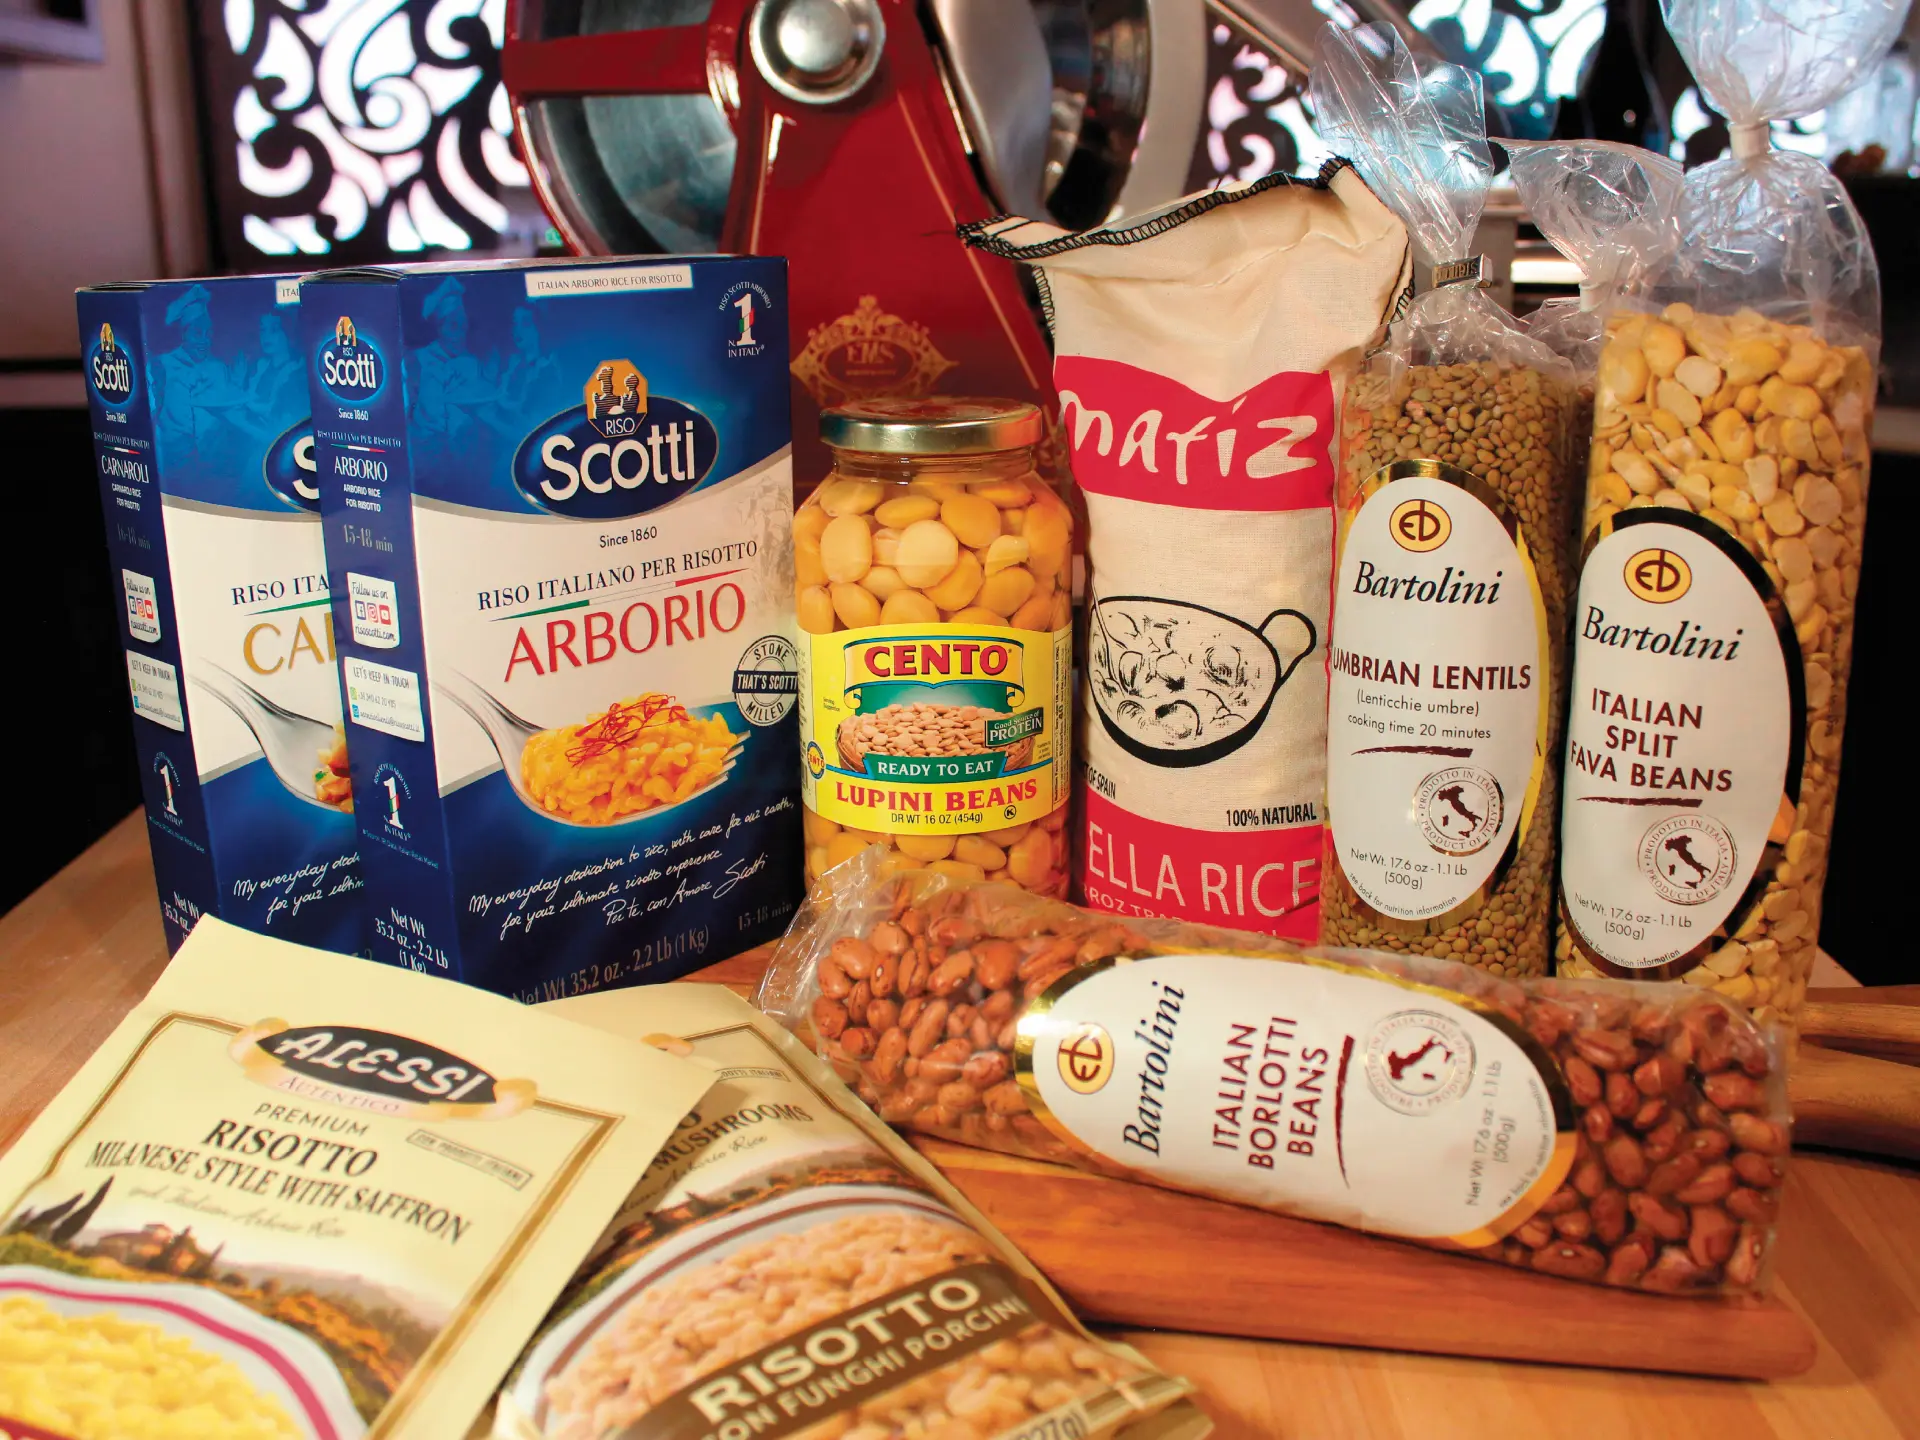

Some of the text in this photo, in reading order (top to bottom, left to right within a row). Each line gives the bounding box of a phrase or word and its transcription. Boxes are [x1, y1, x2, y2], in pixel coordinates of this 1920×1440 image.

[537, 273, 683, 290] ITALIAN ARBORIO RICE FOR RISOTTO
[719, 282, 772, 311] RISO SCOTTI ARBORIO
[734, 293, 756, 346] 1
[324, 351, 376, 388] Scotti
[729, 349, 736, 358] IN
[94, 356, 129, 392] Scotti
[338, 408, 369, 421] Since 1860
[605, 417, 635, 436] RISO
[102, 455, 149, 484] CARNAROLI
[334, 456, 388, 482] ARBORIO
[540, 420, 695, 500] Scotti
[343, 484, 367, 496] ARBORIO
[346, 498, 382, 512] FOR RISOTTO
[376, 537, 394, 553] min
[600, 526, 657, 548] Since 1860
[231, 580, 285, 605] RISO
[352, 582, 388, 600] Follow us on
[477, 540, 758, 611] RISO ITALIANO PER RISOTTO
[1353, 561, 1503, 605] Bartolini
[504, 582, 746, 683] ARBORIO
[1582, 605, 1743, 661] Bartolini
[754, 643, 790, 661] STONE
[864, 644, 1008, 677] CENTO
[1332, 646, 1531, 691] UMBRIAN LENTILS
[391, 675, 409, 689] TOUCH
[738, 674, 767, 690] THAT'S
[746, 701, 784, 720] MILLED
[1357, 688, 1479, 717] (Lenticchie umbre)
[1592, 687, 1702, 729] ITALIAN
[990, 717, 1042, 741] PROTEIN
[994, 720, 1012, 730] Good
[1014, 713, 1033, 724] Source
[1348, 714, 1491, 739] cooking time 20 minutes
[1605, 725, 1678, 758] SPLIT
[878, 760, 993, 777] READY TO EAT
[1570, 741, 1733, 792] FAVA BEANS
[836, 778, 1037, 812] LUPINI BEANS
[1098, 773, 1116, 799] SPAIN
[1419, 770, 1497, 810] PRODOTTO IN ITALIA
[891, 812, 983, 825] DR WT 16 OZ (454g)
[1226, 802, 1317, 827] 100% NATURAL
[1421, 810, 1498, 849] PRODUCT OF ITALY
[1644, 819, 1728, 861] PRODOTTO IN ITALIA
[469, 809, 761, 917] My everyday dedication to rice, with care for our
[1350, 848, 1468, 876] Net Wt. 17.6 oz 1.1 Lb
[234, 862, 328, 900] My everyday
[500, 849, 723, 941] for your ultimate risotto experience
[667, 853, 768, 909] Amore Scotti
[1384, 872, 1423, 890] (500g)
[1648, 863, 1730, 901] PRODUCT OF ITALY
[267, 888, 323, 924] for your
[647, 897, 667, 912] con
[1384, 895, 1458, 917] nutrition information
[1574, 892, 1692, 928] Net 17.6 oz 1.1 Lb
[391, 907, 426, 938] Net Wt
[1605, 921, 1644, 940] (500g)
[375, 918, 448, 969] 35.2 oz. 2.2 Lb
[571, 924, 709, 996] 35.2 2.2 Lb (1 Kg)
[272, 1030, 487, 1103] ALESSI
[1123, 980, 1186, 1158] Bartolini
[277, 1074, 399, 1114] AUTENTICO
[1213, 1023, 1258, 1151] ITALIAN
[1248, 1016, 1298, 1170] BORLOTTI
[1287, 1047, 1329, 1157] BEANS
[254, 1102, 370, 1137] PREMIUM
[652, 1103, 814, 1171] MUSHROOMS
[199, 1118, 380, 1178] RISOTTO
[85, 1140, 473, 1247] MILANESE STYLE WITH SAFFRON
[688, 1278, 980, 1427] RISOTTO
[779, 1348, 906, 1418] FUNGHI
[904, 1296, 1030, 1362] PORCINI
